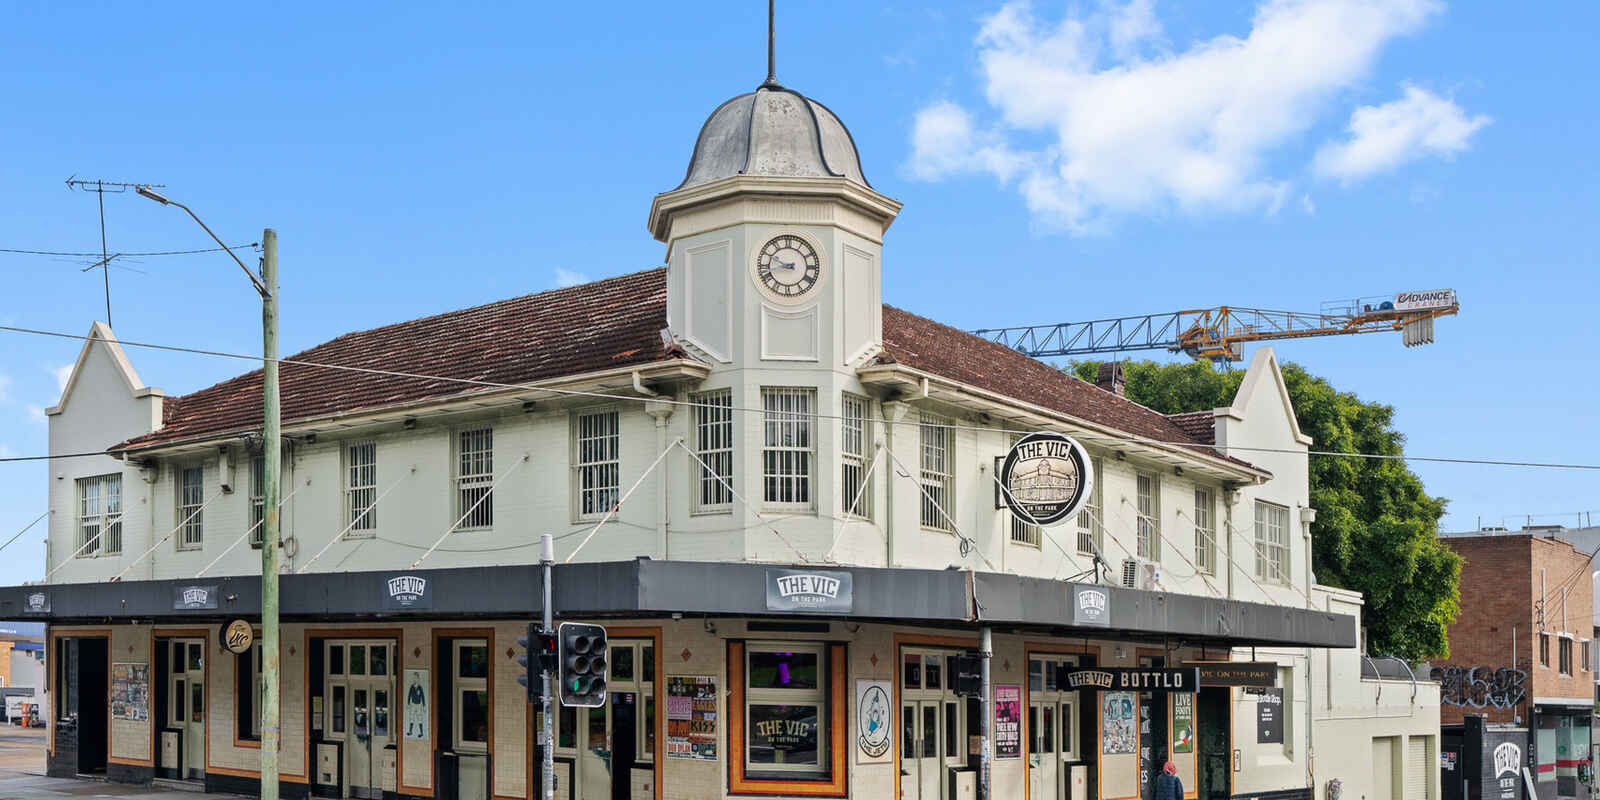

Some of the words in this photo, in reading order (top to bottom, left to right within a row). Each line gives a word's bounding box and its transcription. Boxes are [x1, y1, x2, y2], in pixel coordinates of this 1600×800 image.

[1399, 291, 1449, 303] ADVANCE
[1018, 441, 1043, 459] THE
[1046, 441, 1069, 458] VIC
[389, 579, 406, 595] THE
[407, 578, 424, 594] VIC
[779, 577, 808, 593] THE
[810, 577, 837, 595] VIC
[1080, 592, 1092, 608] THE
[1070, 672, 1091, 685] THE
[1091, 673, 1112, 687] VIC
[1121, 672, 1182, 687] BOTTLO
[1176, 692, 1191, 705] LIVE
[1176, 706, 1191, 715] FOOTY
[691, 720, 714, 731] KISS
[756, 720, 783, 736] THE
[785, 720, 809, 737] VIC
[1496, 746, 1507, 773] THE
[1507, 745, 1518, 770] VIC
